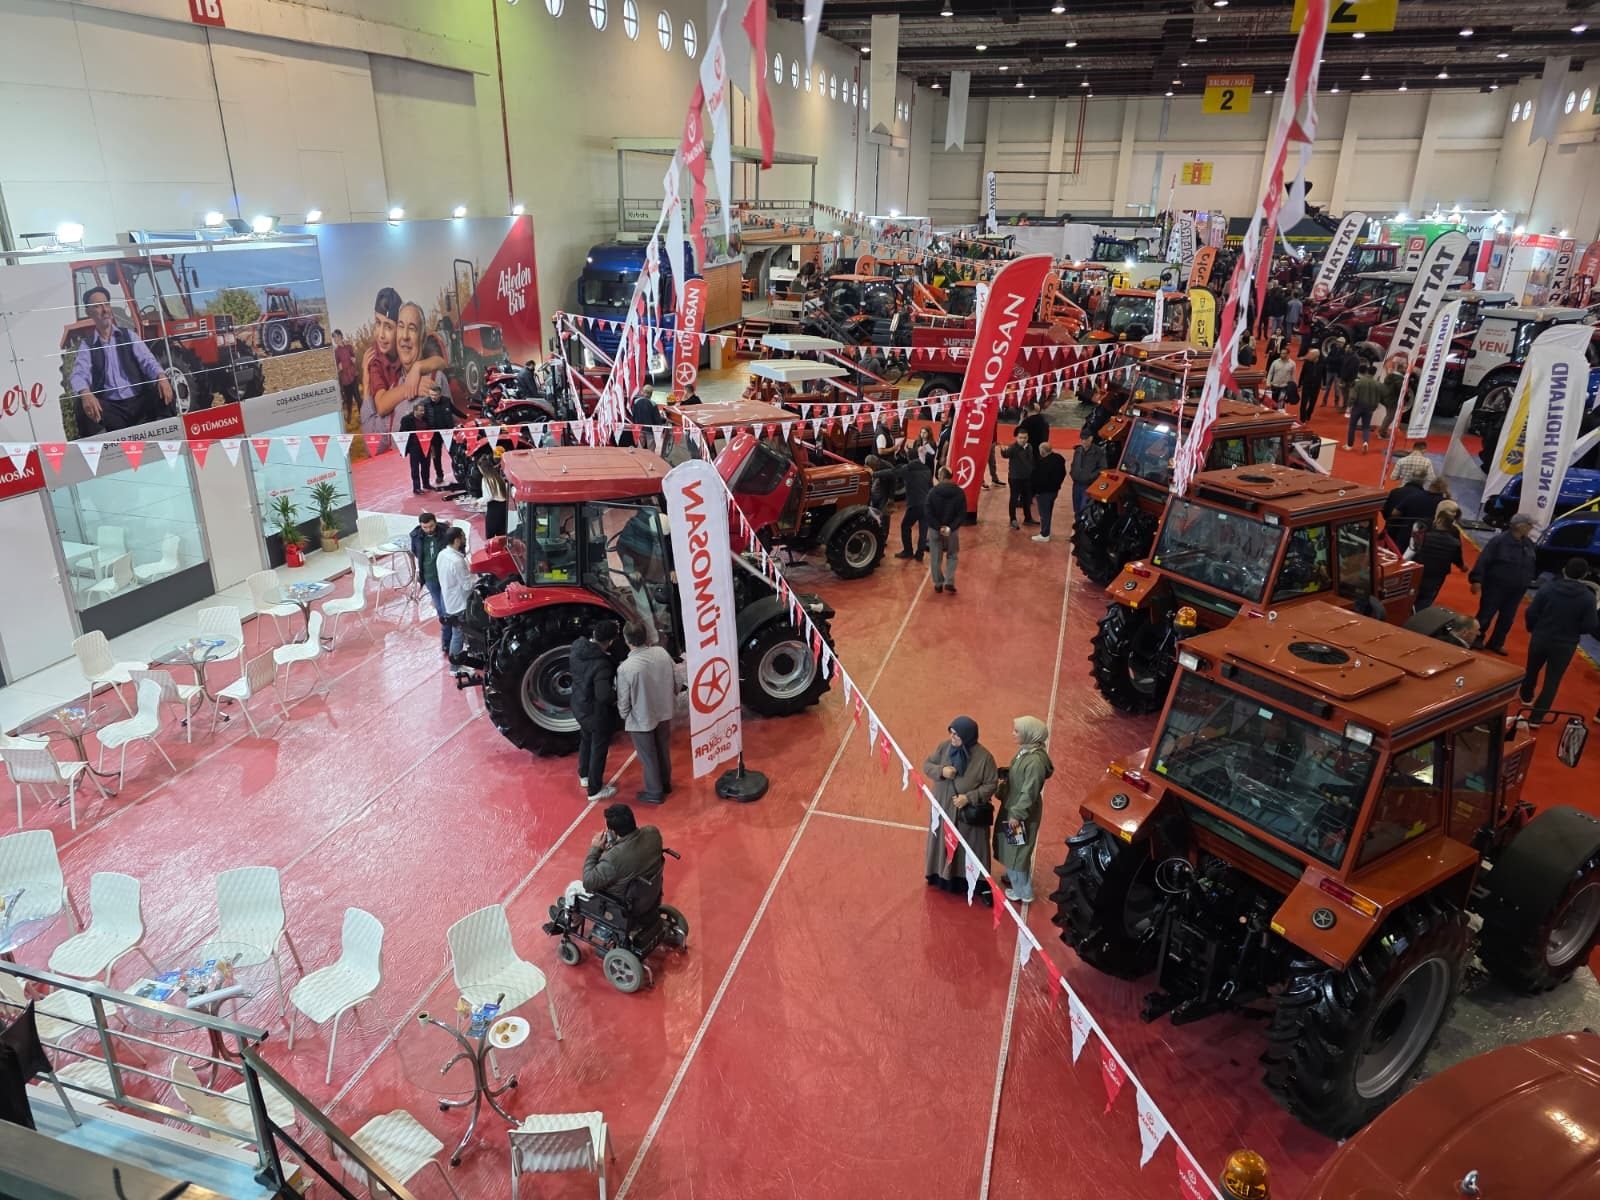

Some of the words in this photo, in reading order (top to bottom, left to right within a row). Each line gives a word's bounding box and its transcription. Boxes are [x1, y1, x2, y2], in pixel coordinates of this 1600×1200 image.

[1220, 89, 1235, 110] 2
[1322, 219, 1358, 281] HATTAT
[508, 288, 526, 316] Biri
[1398, 245, 1456, 350] HATTAT
[1429, 314, 1451, 373] HOLLAND
[963, 293, 1025, 449] TÜMOSAN
[0, 382, 45, 419] ere
[1423, 376, 1437, 404] NEW
[149, 424, 179, 438] ALETLER
[201, 416, 239, 432] TÜMOSAN
